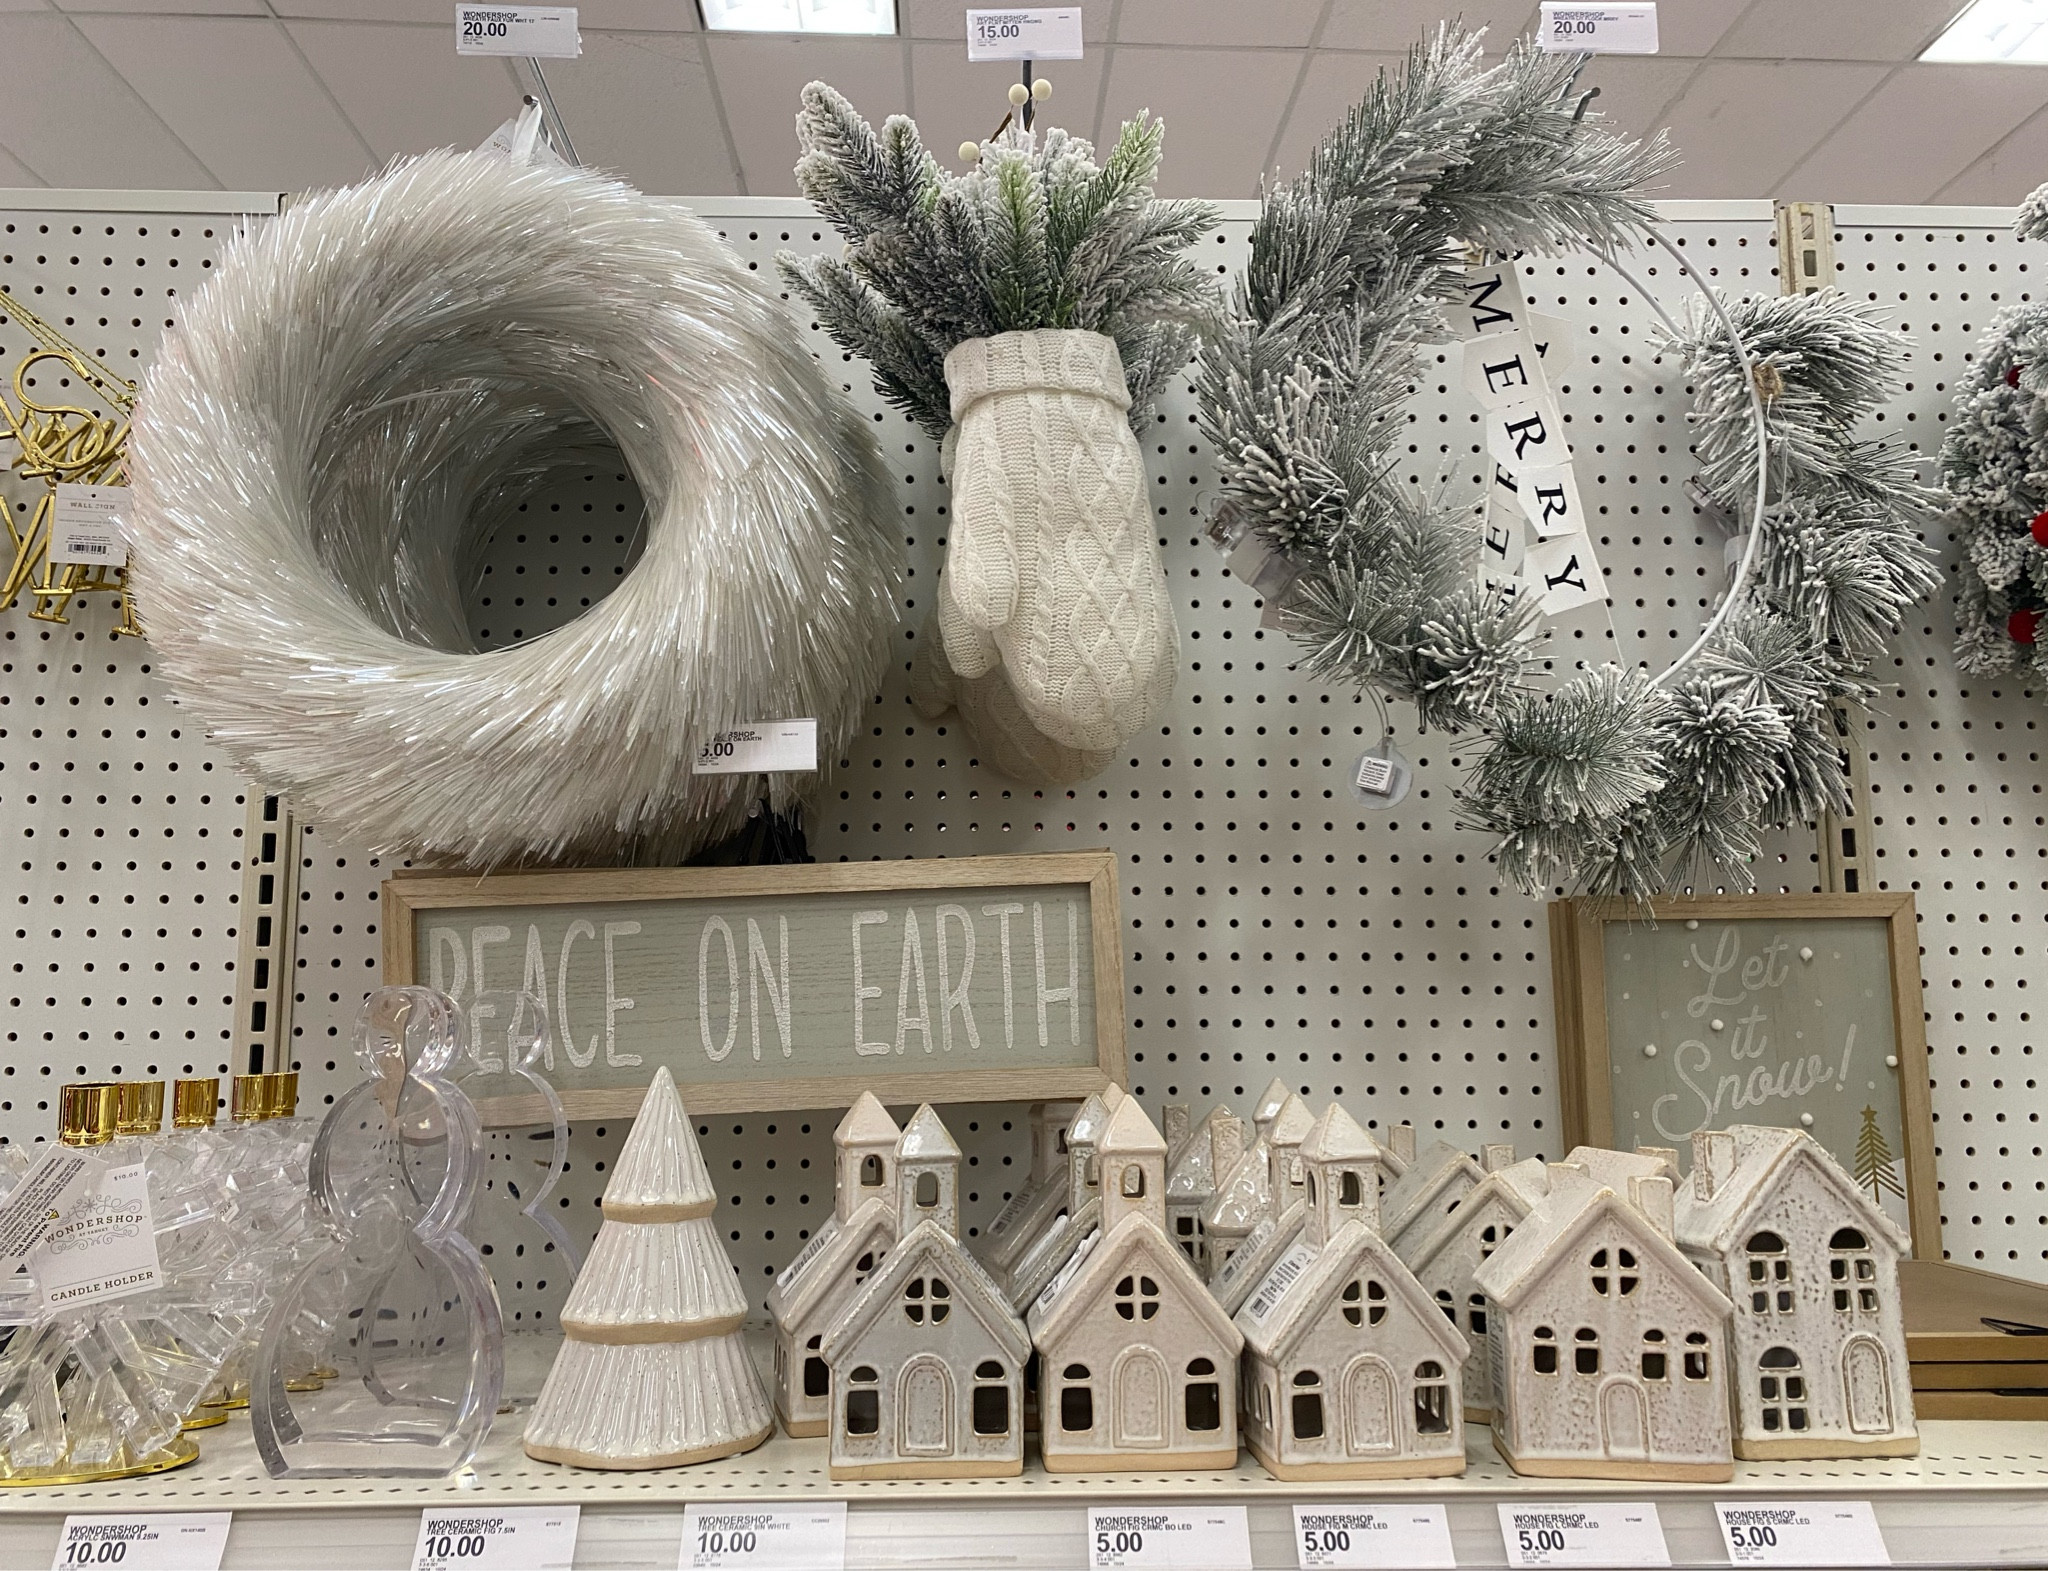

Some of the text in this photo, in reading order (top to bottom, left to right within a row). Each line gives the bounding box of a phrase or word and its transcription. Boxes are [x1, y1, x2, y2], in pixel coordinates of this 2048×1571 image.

[463, 11, 518, 20] WONDERSHOP
[463, 22, 507, 36] 20.00
[978, 25, 1019, 38] 15.00
[1553, 21, 1595, 34] 20.00
[1464, 273, 1586, 591] MERRY
[1687, 925, 1789, 1018] Let
[429, 900, 1081, 1075] PEACE ON EARTH
[1730, 1005, 1767, 1061] it
[1652, 1024, 1856, 1142] Snow!
[114, 1171, 138, 1181] $10.00
[20, 1218, 46, 1242] Prevent
[45, 1215, 143, 1244] WONDERSHOP
[9, 1244, 23, 1256] Fire
[51, 1271, 154, 1302] CANDLE HOLDER
[698, 1515, 773, 1525] WONDERSHOP
[1095, 1516, 1169, 1525] WONDERSHOP
[1301, 1515, 1374, 1524] WONDERSHOP
[1513, 1514, 1586, 1523] WONDERSHOP
[1723, 1511, 1796, 1520] WONDERSHOP
[1725, 1518, 1751, 1526] HOUSE
[1753, 1518, 1765, 1526] FIG
[70, 1525, 147, 1535] WONDERSHOP
[428, 1519, 503, 1529] WONDERSHOP
[718, 1523, 752, 1531] CERAMIC
[67, 1533, 98, 1541] ACRYLC
[100, 1533, 135, 1541] SNWMAN
[447, 1527, 482, 1535] CERAMIC
[1731, 1526, 1777, 1547] 5.00
[425, 1536, 485, 1557] 10.00
[698, 1532, 756, 1553] 10.00
[1097, 1532, 1143, 1552] 5.00
[1305, 1531, 1350, 1551] 5.00
[1519, 1530, 1565, 1550] 5.00
[65, 1542, 127, 1563] 10.00
